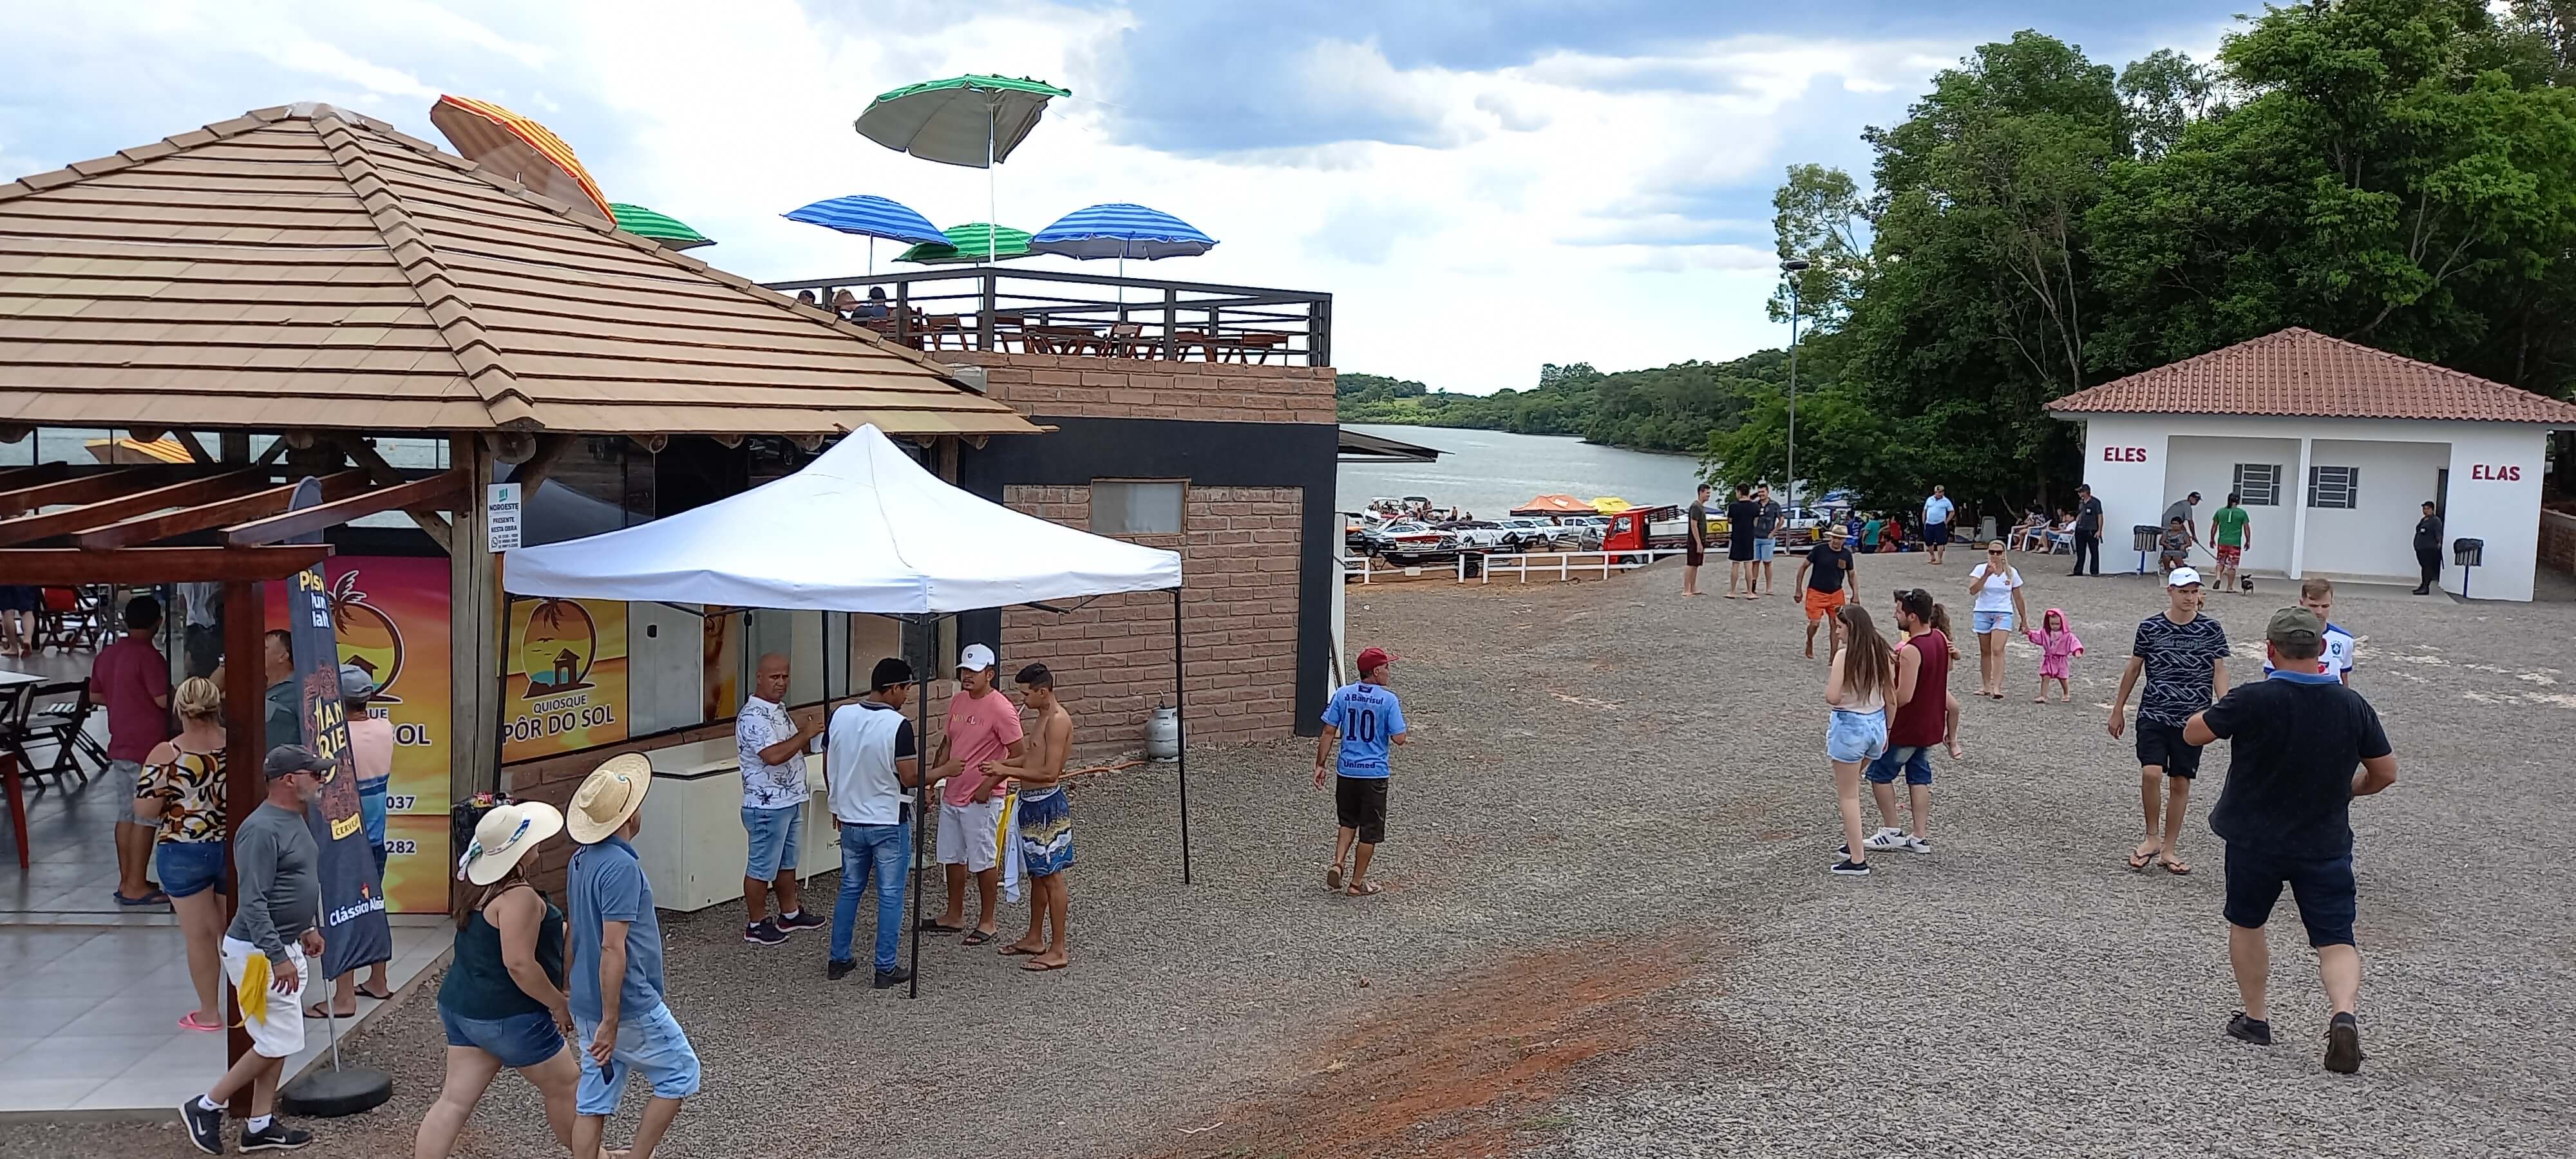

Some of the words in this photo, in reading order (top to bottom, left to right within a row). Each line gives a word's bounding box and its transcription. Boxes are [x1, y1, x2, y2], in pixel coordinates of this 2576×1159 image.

[2103, 447, 2146, 462] ELES
[2472, 464, 2521, 482] ELAS
[489, 503, 519, 511] NOROESTE
[533, 694, 587, 714] QUIOSQUE
[1351, 693, 1384, 705] Banrisul
[504, 716, 542, 743] PÔR
[548, 712, 576, 735] DO
[581, 705, 614, 728] SOL
[1346, 708, 1375, 743] 10
[1343, 760, 1376, 769] Unimed
[330, 900, 369, 927] Clássico
